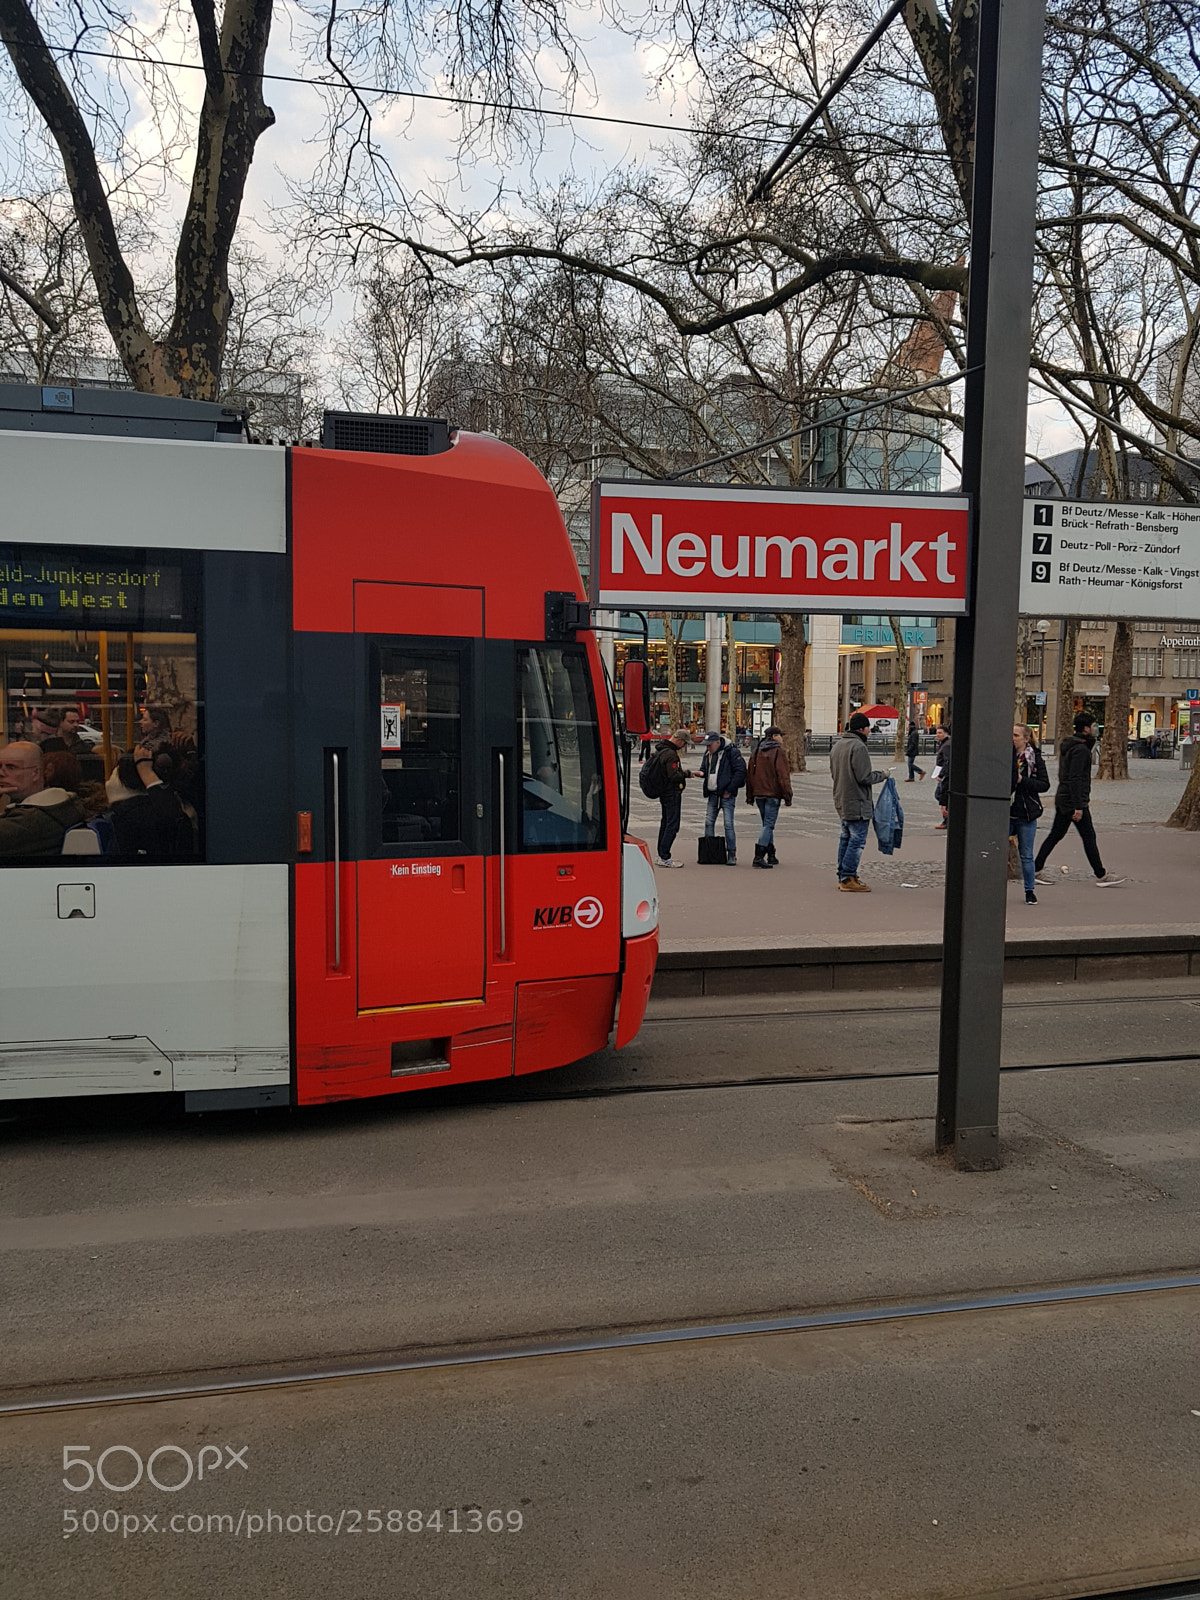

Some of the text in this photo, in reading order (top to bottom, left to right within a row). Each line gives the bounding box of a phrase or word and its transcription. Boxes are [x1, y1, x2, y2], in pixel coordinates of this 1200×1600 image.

[1039, 507, 1047, 524] 1
[1062, 506, 1073, 516] Bf
[611, 512, 956, 583] Neumarkt
[1037, 536, 1048, 552] 7
[1035, 565, 1047, 580] 9
[1059, 563, 1071, 572] Bf
[59, 589, 128, 609] West
[855, 629, 925, 643] PRIMRK
[1188, 690, 1198, 700] U
[392, 862, 441, 876] Kein Einstieg
[533, 906, 573, 926] KVB
